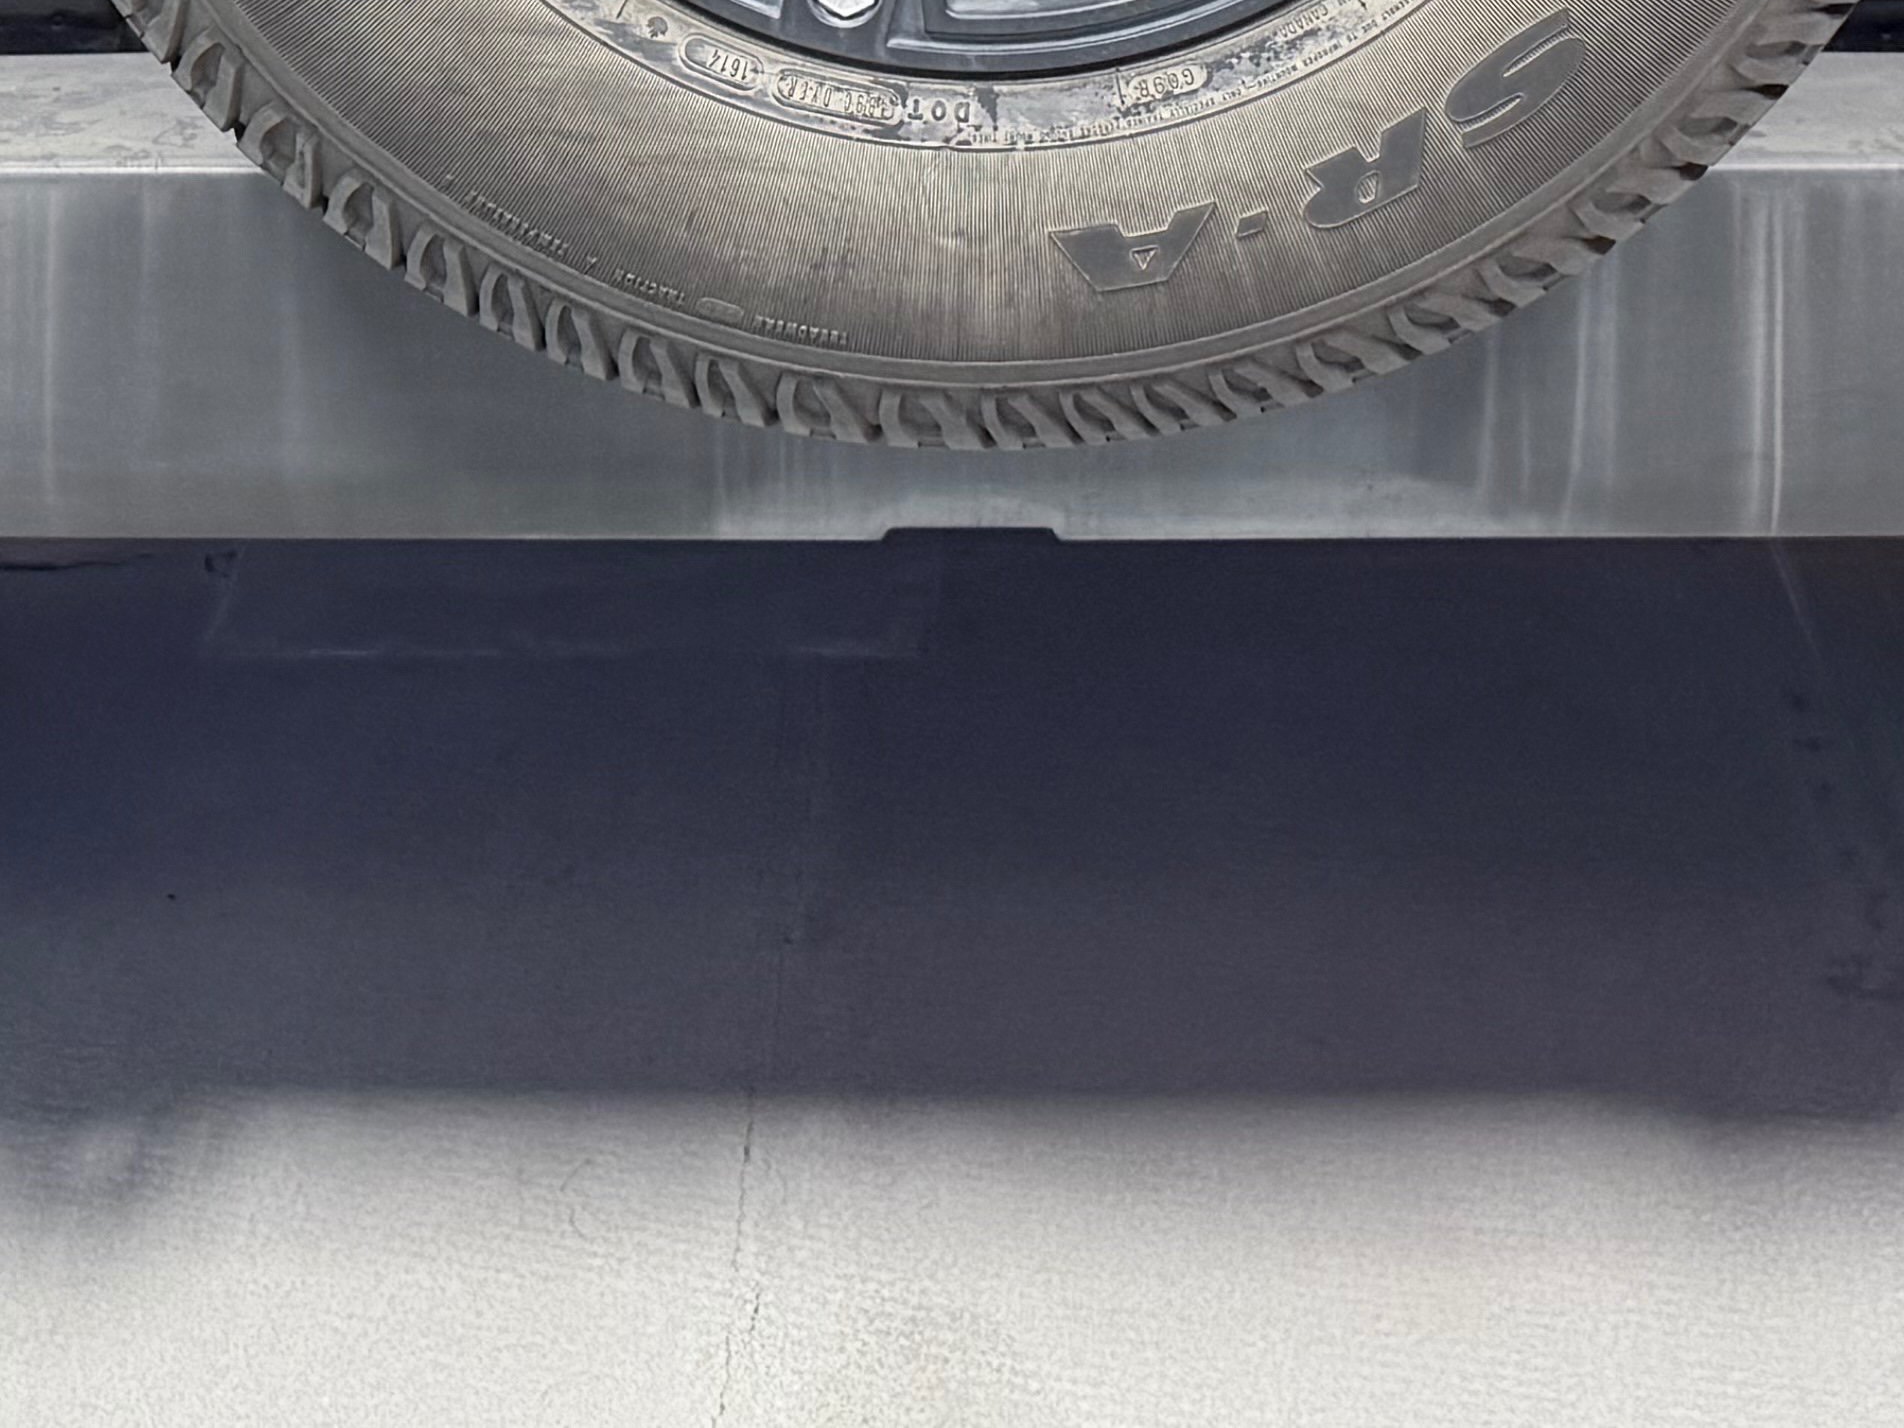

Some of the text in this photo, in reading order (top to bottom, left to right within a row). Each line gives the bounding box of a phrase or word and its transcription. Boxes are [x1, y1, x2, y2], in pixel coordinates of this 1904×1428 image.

[1276, 0, 1333, 42] CANADA
[705, 46, 754, 84] 1614
[905, 94, 973, 125] DOT
